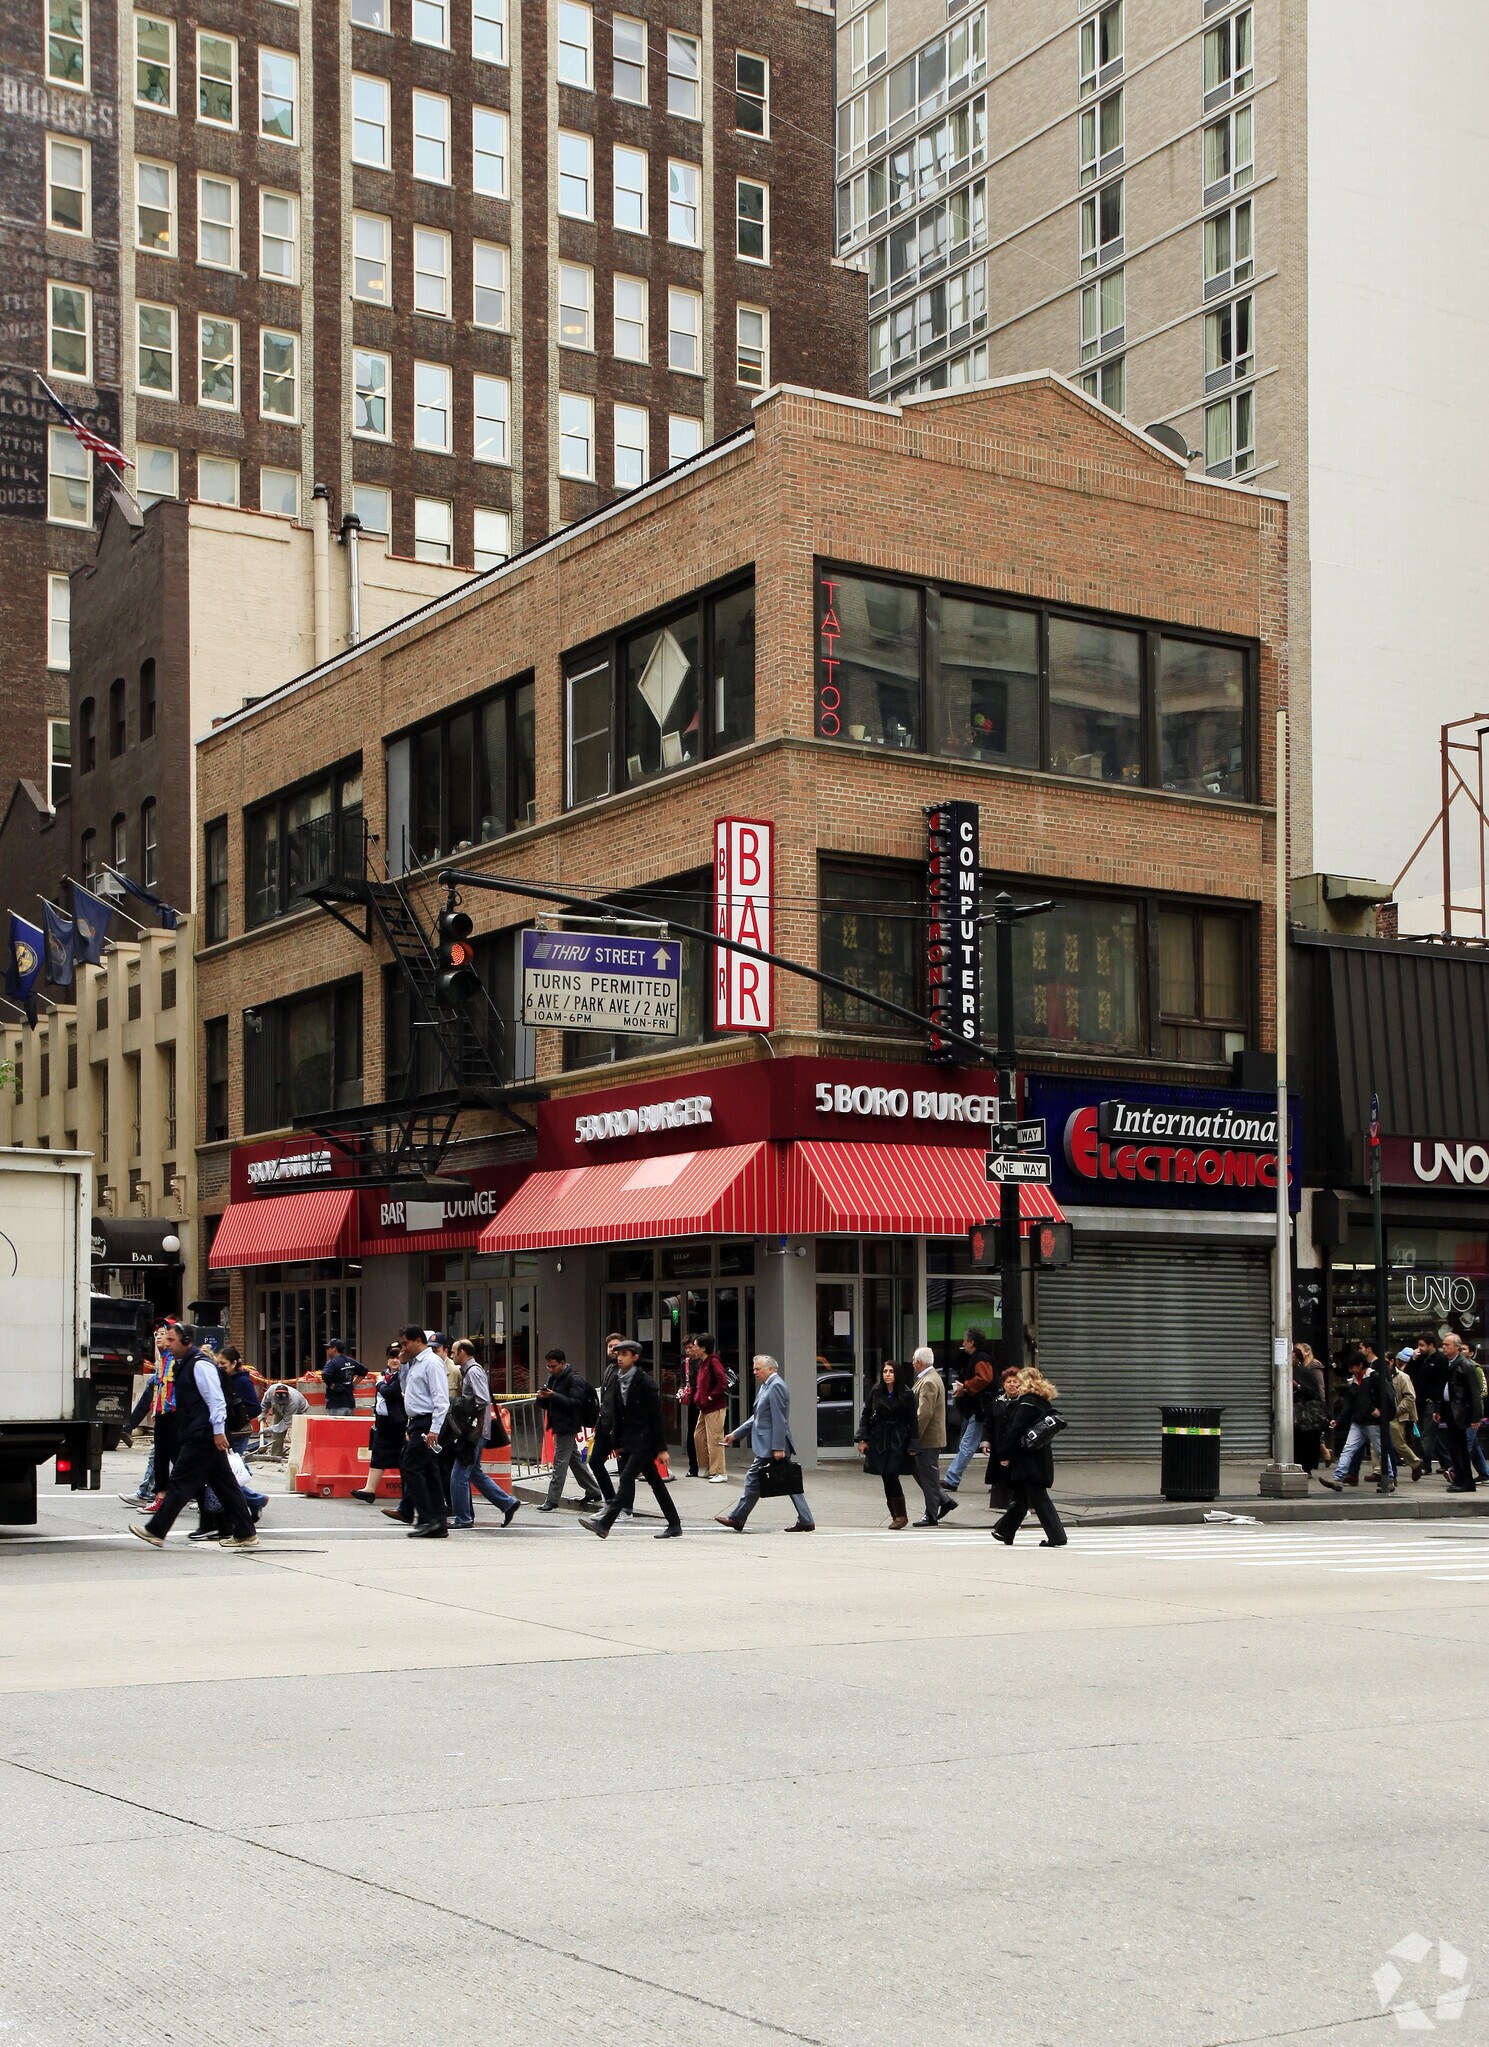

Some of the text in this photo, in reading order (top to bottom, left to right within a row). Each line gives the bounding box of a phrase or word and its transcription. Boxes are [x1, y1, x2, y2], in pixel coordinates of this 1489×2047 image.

[821, 578, 841, 736] TATTOO
[739, 828, 762, 1022] BAR
[959, 821, 976, 1039] COMPUTERS
[550, 944, 646, 966] THRU STREET
[533, 973, 671, 998] TURNS PERMITTED
[526, 993, 533, 1008] 6
[537, 994, 559, 1009] AVE
[574, 996, 605, 1012] PARK
[609, 998, 630, 1014] AVE
[644, 1001, 651, 1016] 2
[655, 1002, 676, 1018] AVE
[533, 1010, 592, 1023] 10AM-6PM
[623, 1017, 669, 1030] MON-FRI
[638, 1095, 712, 1133] BURGER
[913, 1090, 999, 1124] BURGE
[1112, 1104, 1278, 1143] Internationa
[1021, 1129, 1039, 1142] WAY
[995, 1162, 1042, 1175] ONE WAY
[1413, 1142, 1489, 1184] UNO
[380, 1190, 496, 1225] BAR LOUNGE
[1406, 1275, 1475, 1312] UNO
